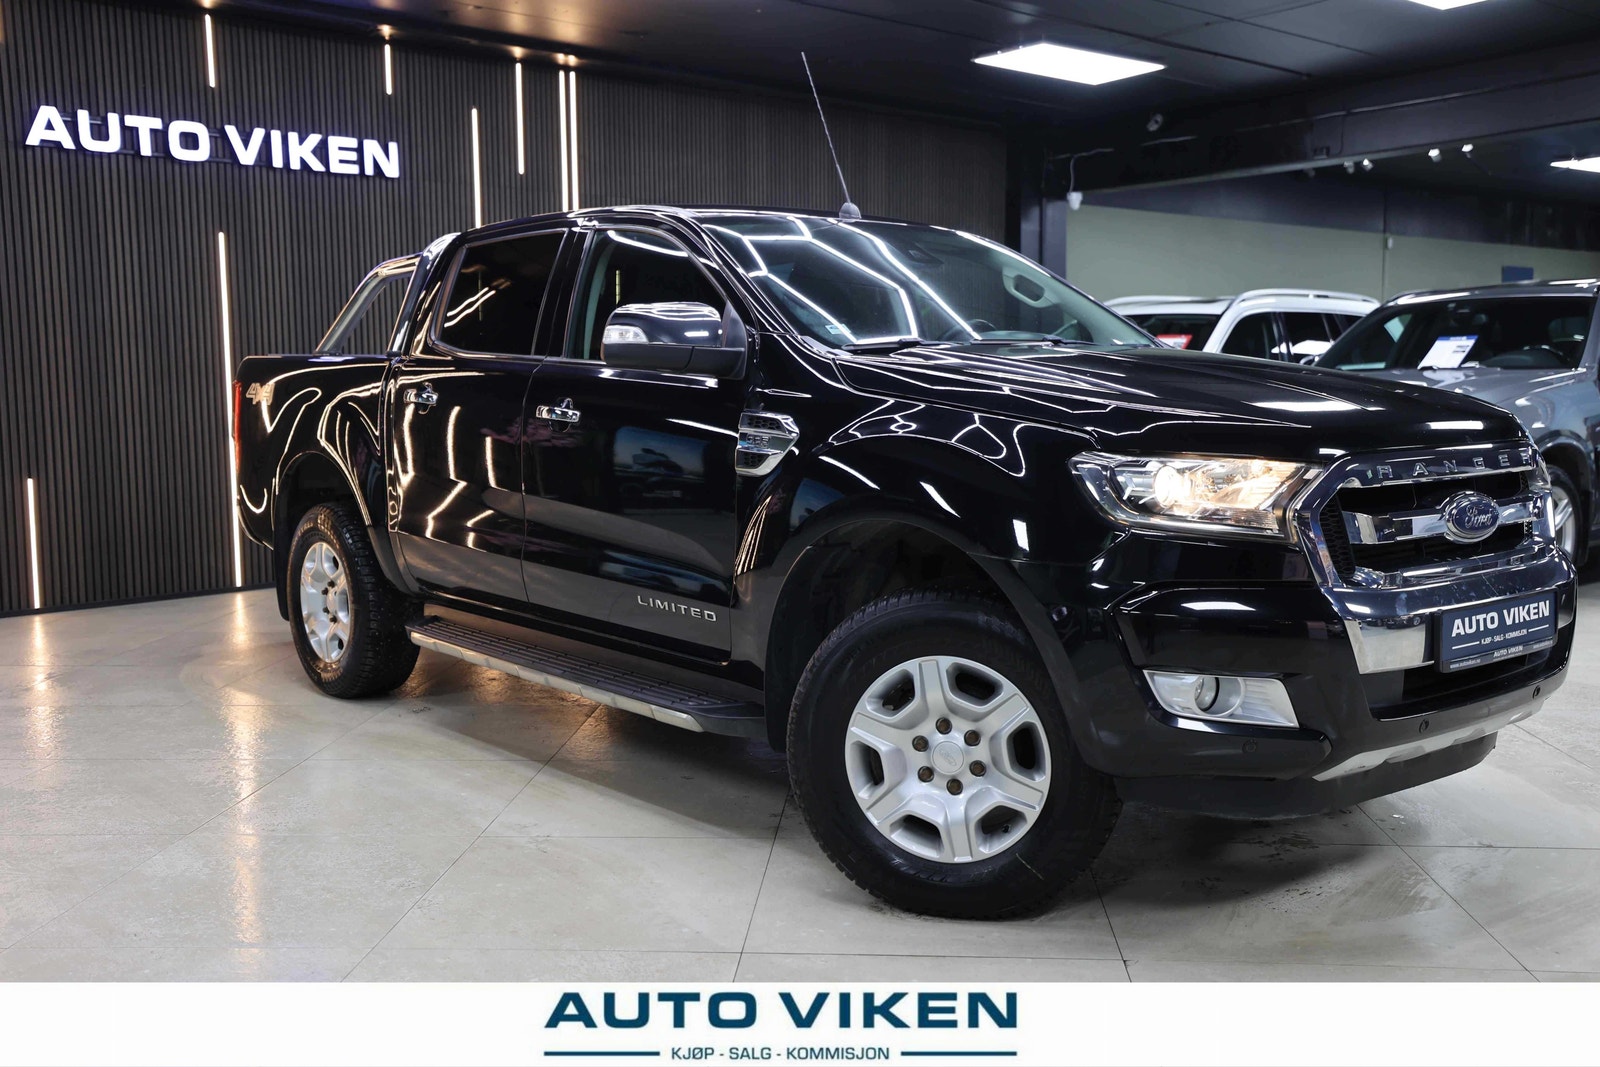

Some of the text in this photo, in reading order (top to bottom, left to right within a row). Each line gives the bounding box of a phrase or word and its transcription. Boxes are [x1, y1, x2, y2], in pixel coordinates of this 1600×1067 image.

[25, 105, 400, 178] AUTO VIKEN
[1376, 452, 1532, 479] RANGER
[1465, 504, 1493, 529] Ford
[637, 595, 717, 621] LIMITED
[1451, 600, 1550, 637] AUTO VIKEN
